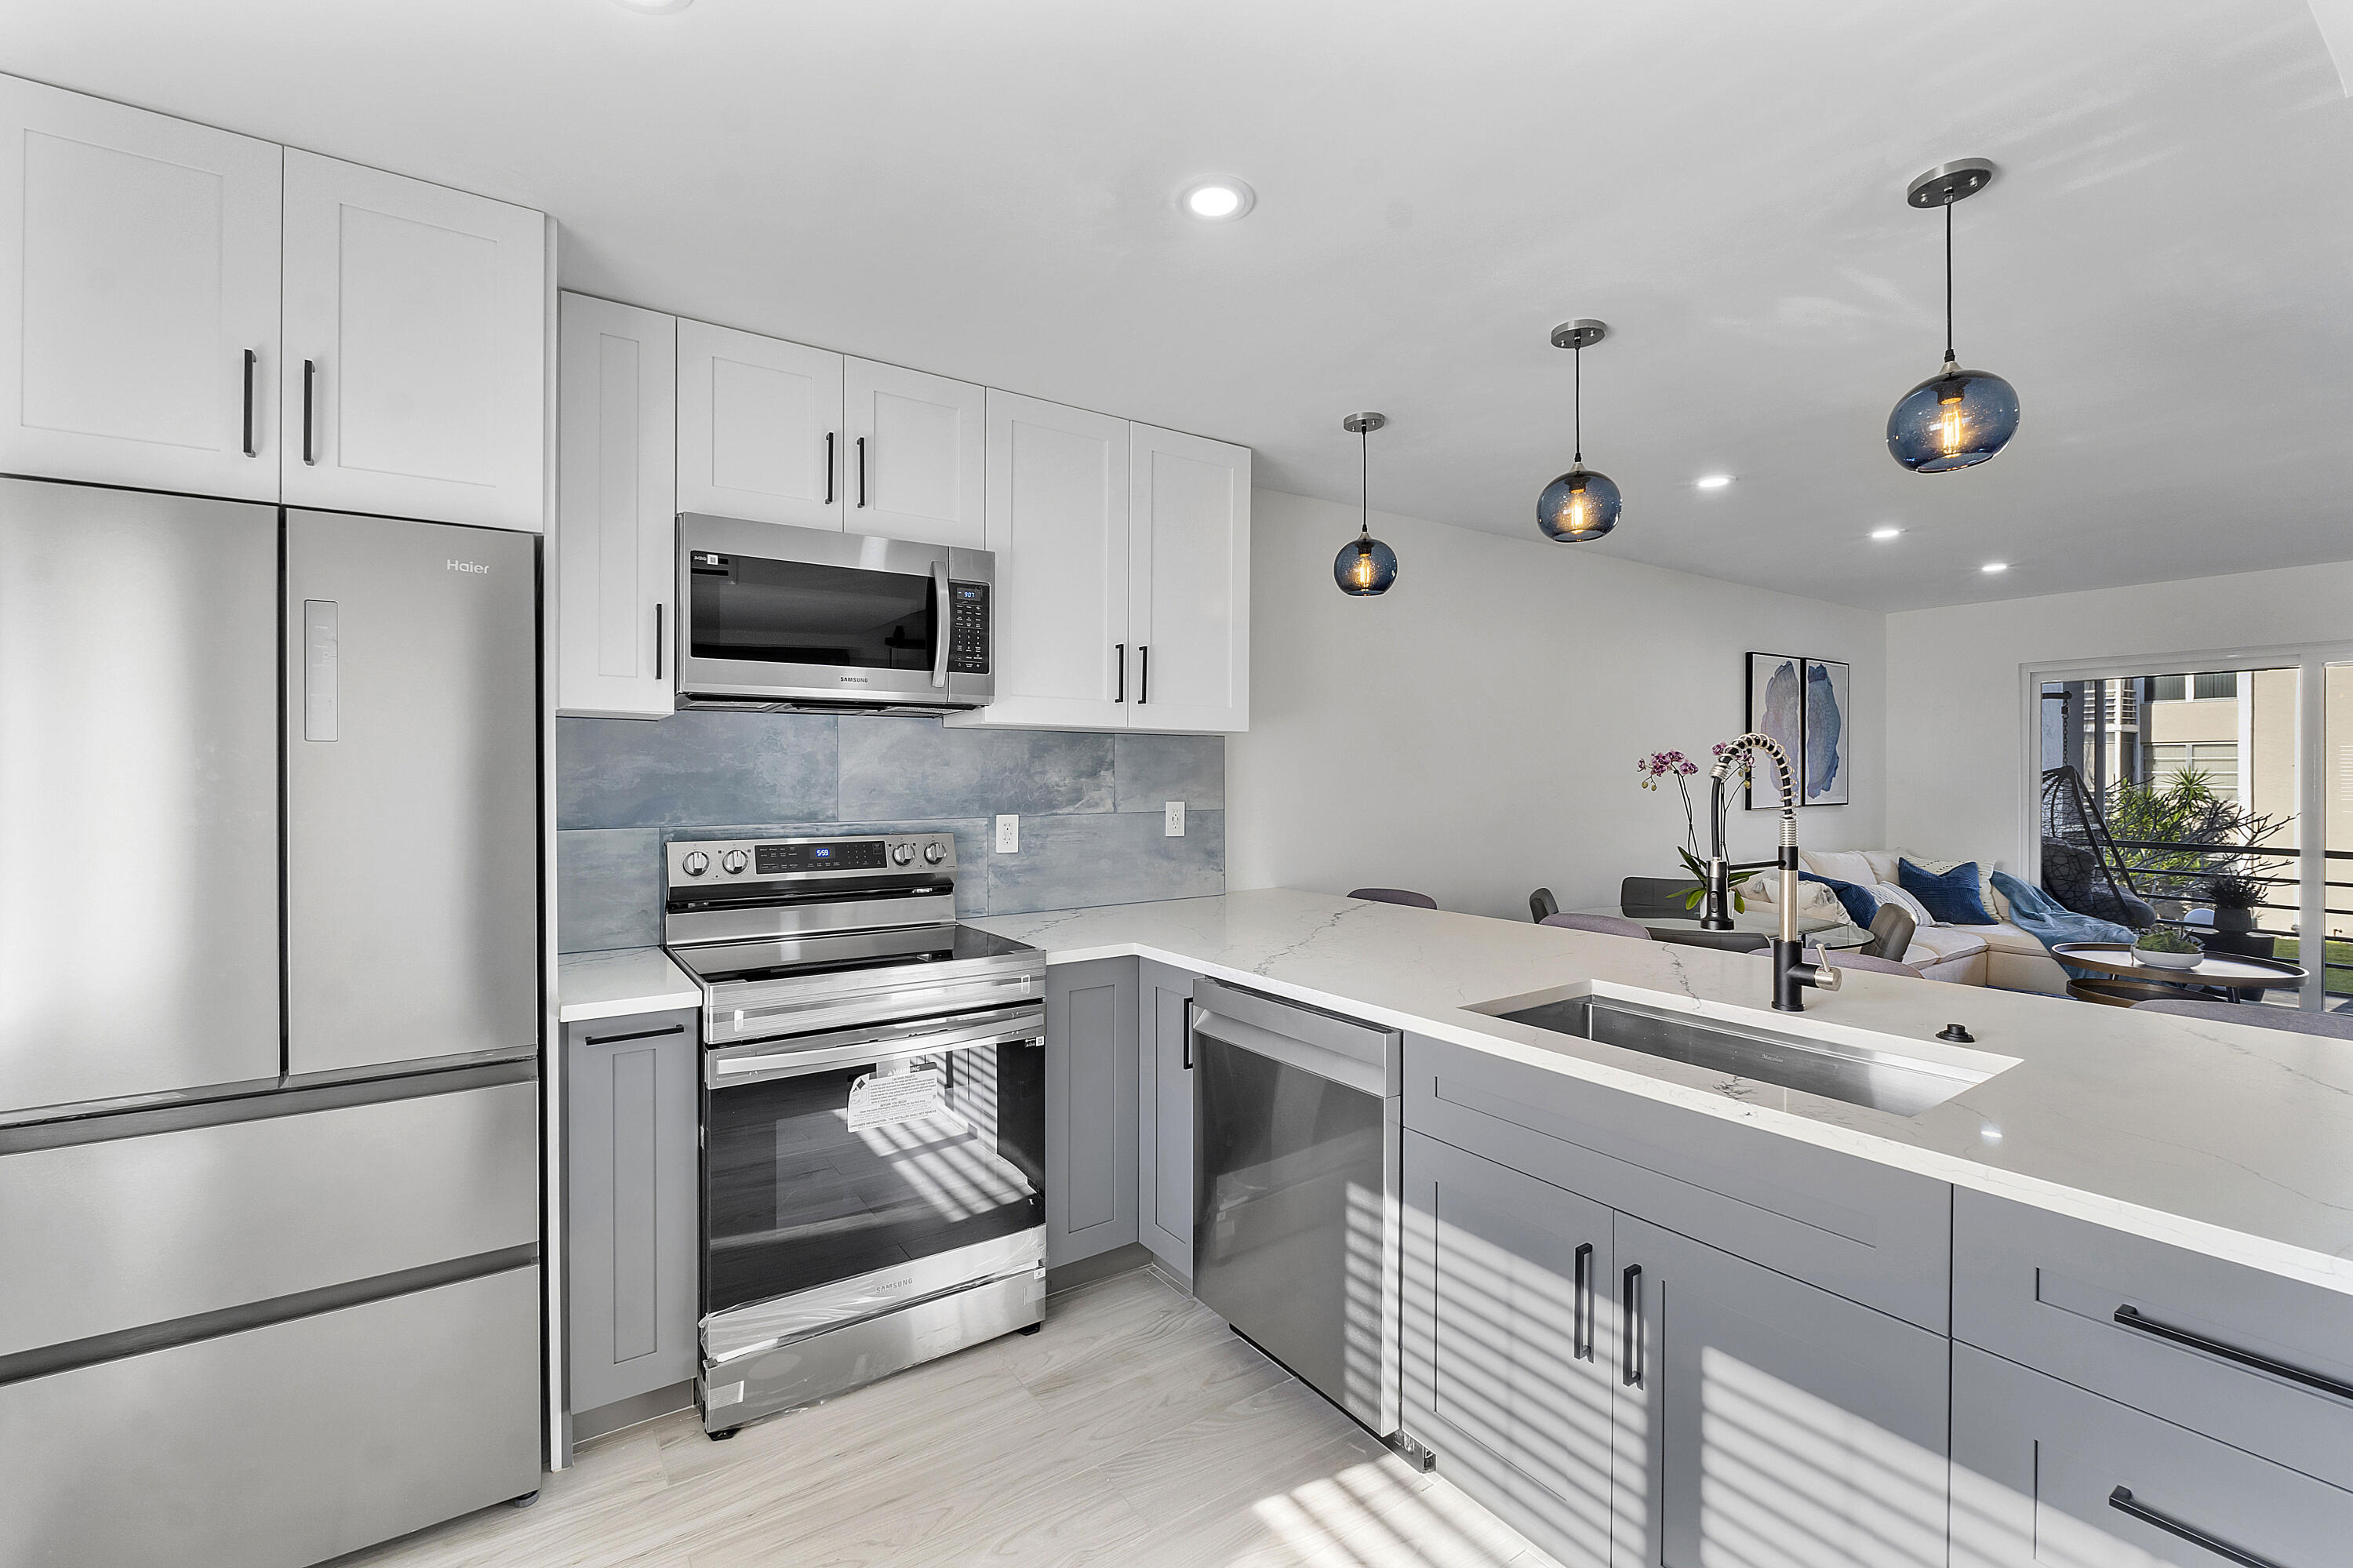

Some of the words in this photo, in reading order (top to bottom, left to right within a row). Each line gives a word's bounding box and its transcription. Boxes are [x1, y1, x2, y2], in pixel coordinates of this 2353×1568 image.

[446, 558, 489, 574] Haier
[893, 1066, 920, 1075] WAING
[876, 1278, 913, 1293] SAMSUNG
